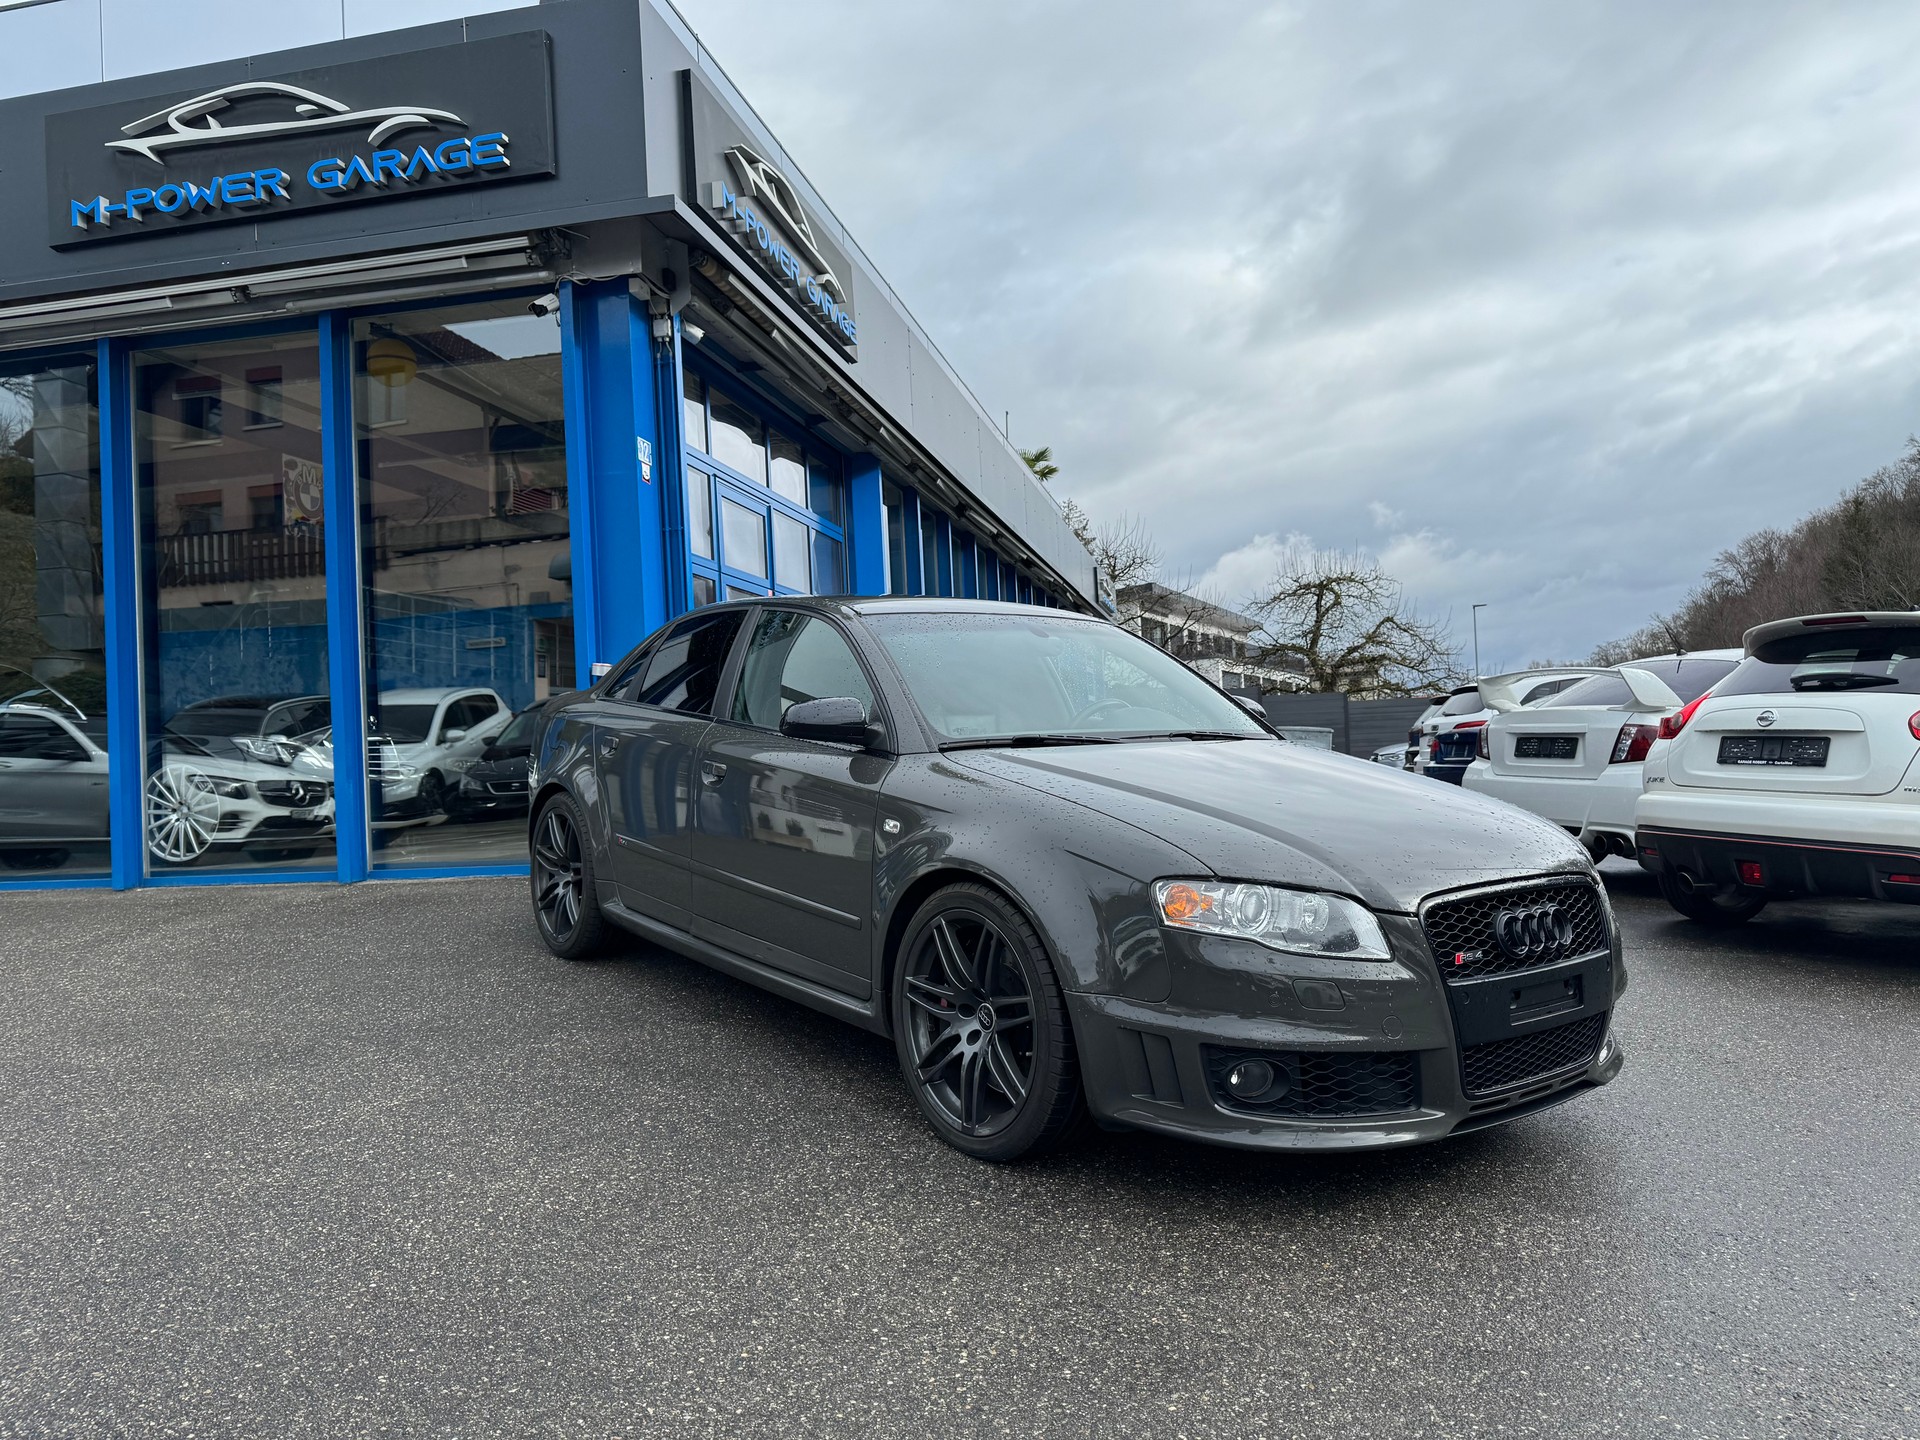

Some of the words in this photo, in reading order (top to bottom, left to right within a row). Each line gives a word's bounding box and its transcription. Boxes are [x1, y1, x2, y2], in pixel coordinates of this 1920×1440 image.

[71, 168, 289, 227] M-POWER
[307, 132, 509, 190] GARAGE
[721, 181, 801, 287] M-POWER
[806, 275, 857, 346] GARAGE
[1646, 776, 1665, 784] JUKE
